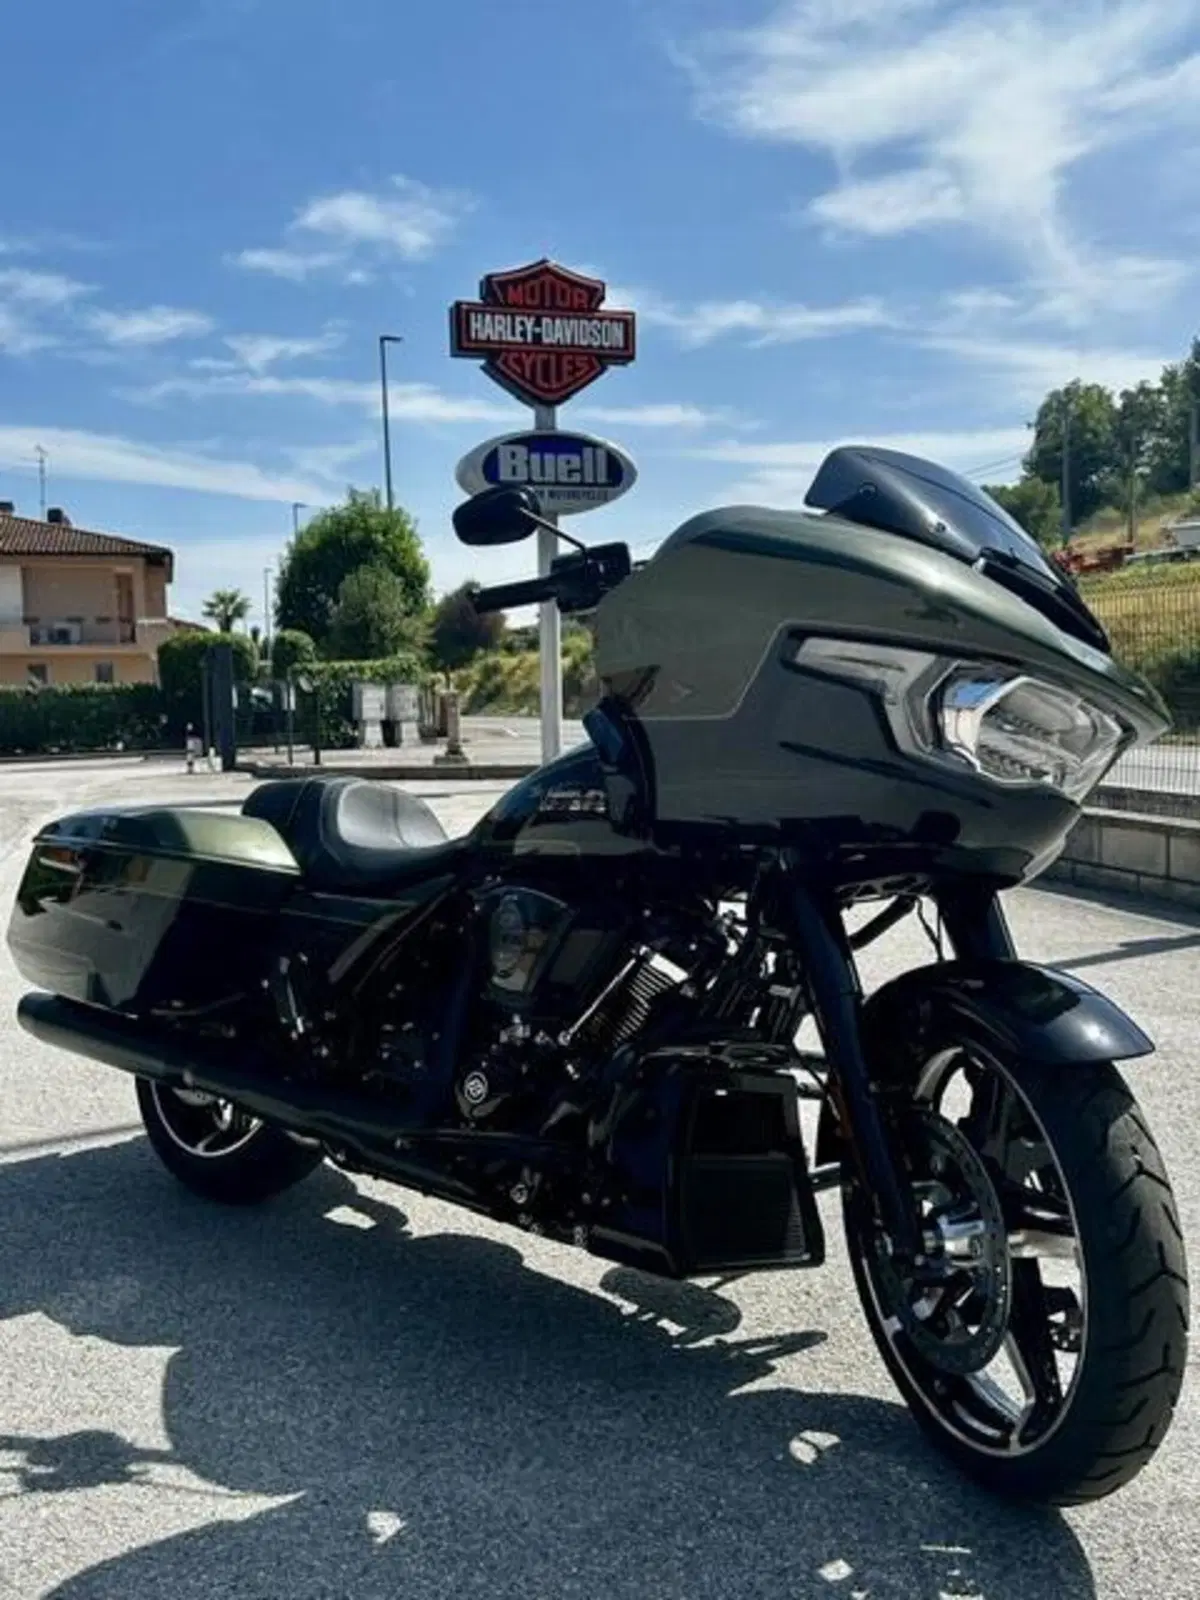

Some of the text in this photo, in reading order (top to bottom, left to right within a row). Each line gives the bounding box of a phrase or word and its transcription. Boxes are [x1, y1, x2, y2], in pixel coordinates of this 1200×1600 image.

[507, 279, 589, 309] MOTOR
[470, 311, 624, 348] HARLEY-DAVIDSON
[509, 352, 592, 389] CYCLES
[497, 444, 609, 483] Buell
